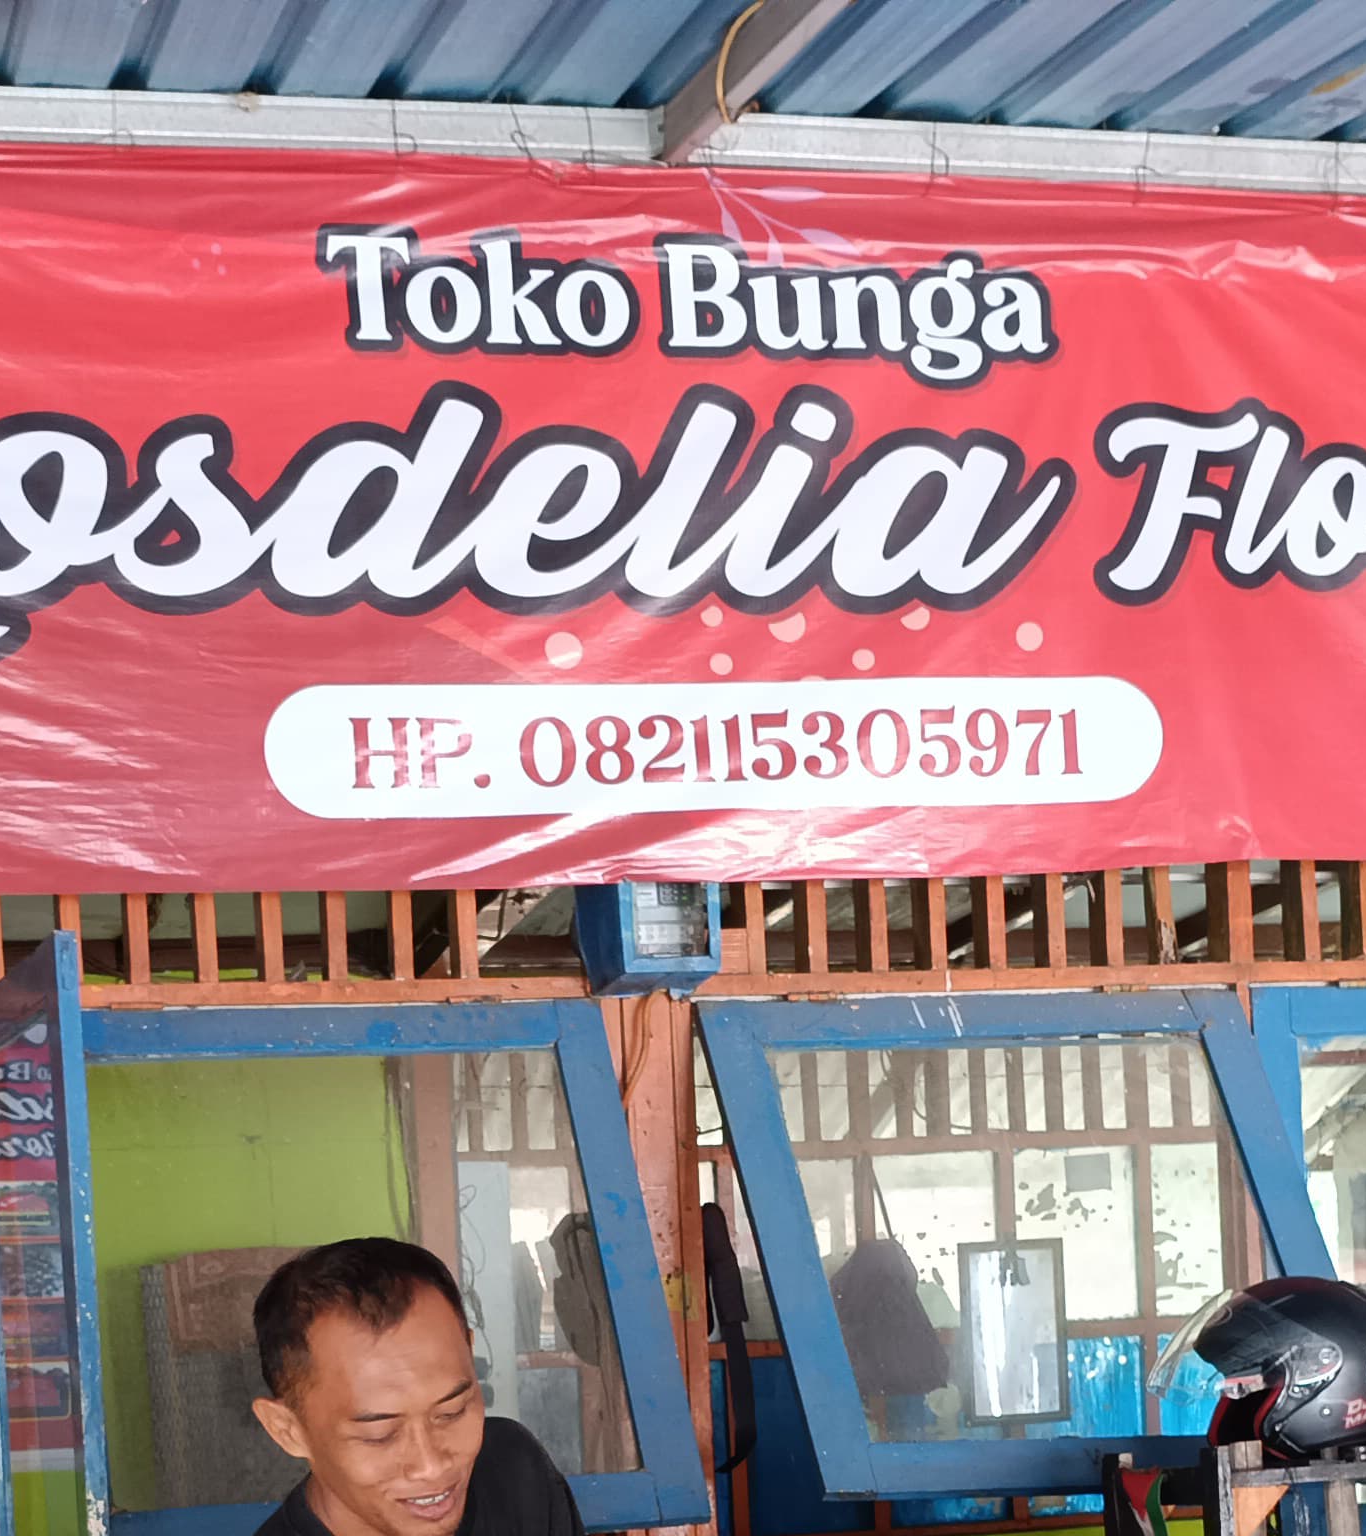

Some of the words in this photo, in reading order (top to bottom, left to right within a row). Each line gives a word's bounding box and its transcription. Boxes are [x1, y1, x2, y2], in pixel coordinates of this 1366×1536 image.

[325, 231, 631, 348] Toko
[664, 238, 1052, 380] Bunga
[345, 713, 493, 792] HP.
[517, 705, 1085, 790] 082115305971
